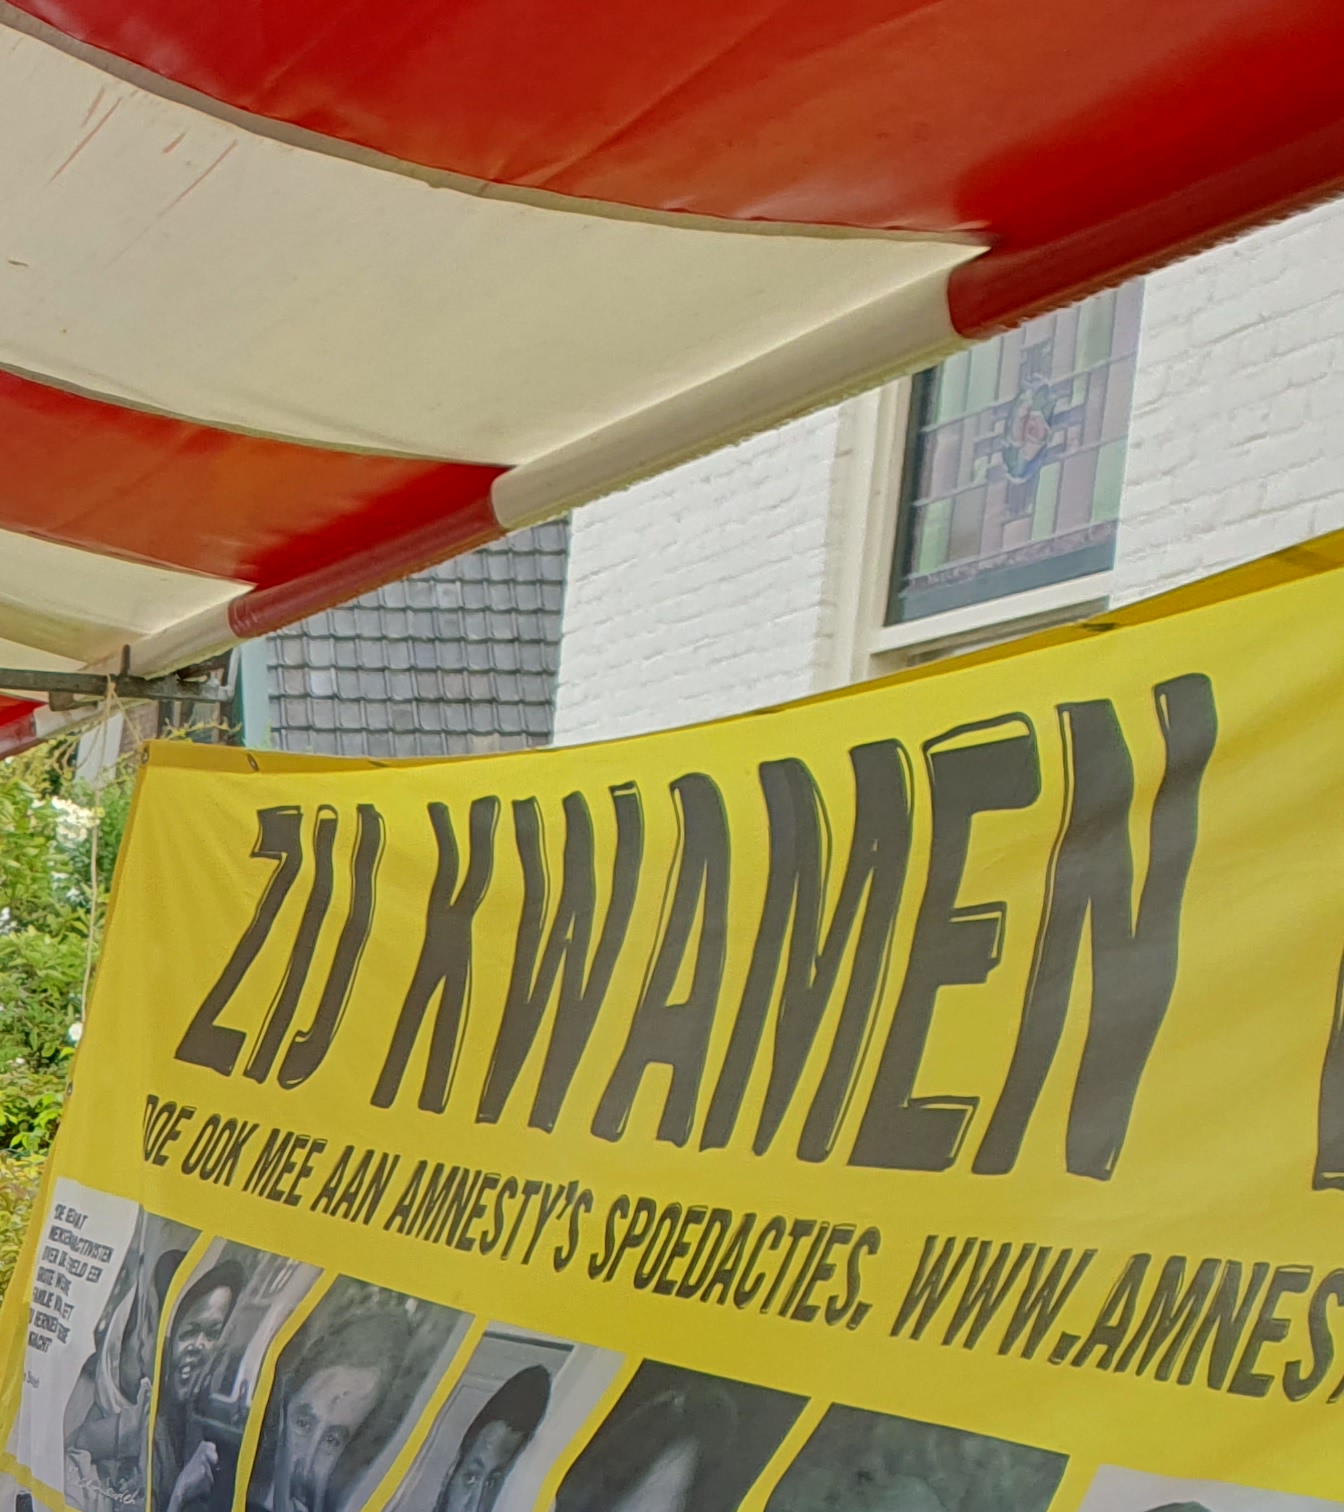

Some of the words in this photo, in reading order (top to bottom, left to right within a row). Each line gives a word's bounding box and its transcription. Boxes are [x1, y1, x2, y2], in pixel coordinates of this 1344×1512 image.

[174, 802, 386, 1090] ZIJ
[370, 672, 1219, 1181] KWAMEN
[180, 1113, 261, 1188] OOK
[241, 1127, 328, 1207] MEE
[309, 1144, 402, 1226] AAN
[382, 1158, 594, 1274] AMNESTY'S
[587, 1193, 882, 1331] SPOEDACTIES.
[888, 1234, 1344, 1405] WWW.AMNES
